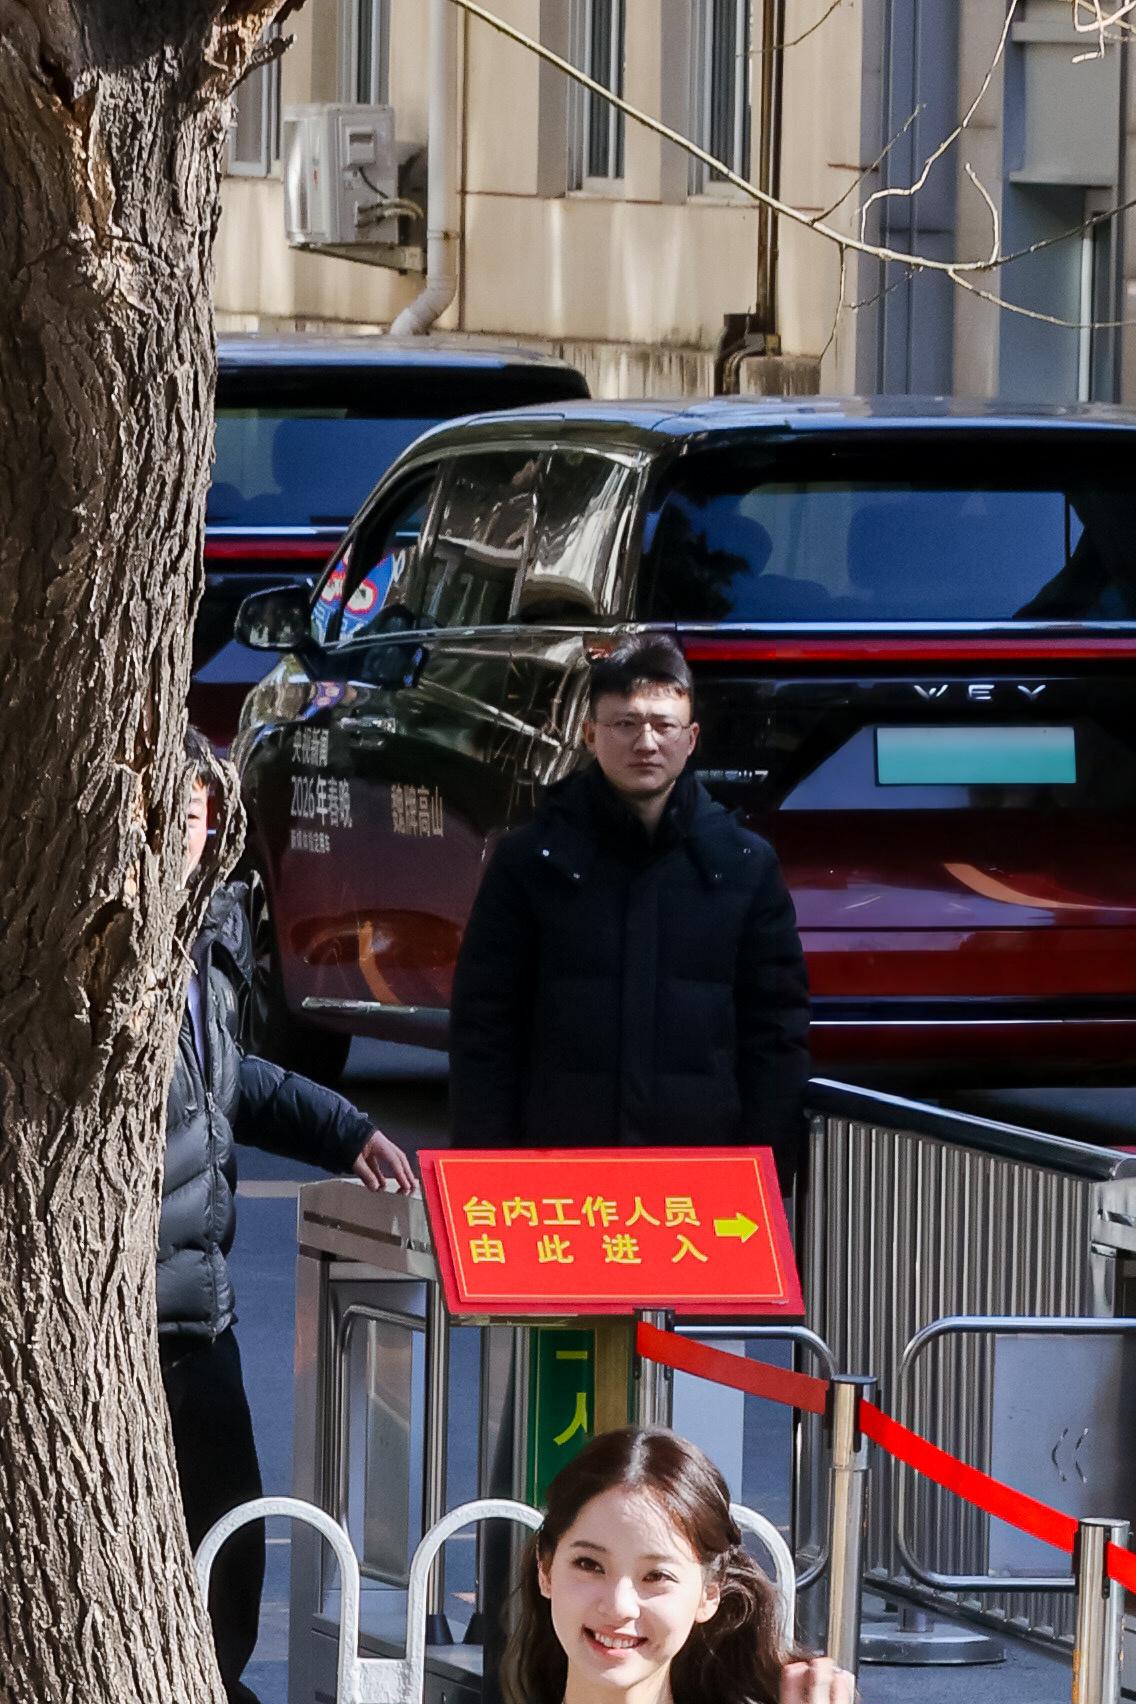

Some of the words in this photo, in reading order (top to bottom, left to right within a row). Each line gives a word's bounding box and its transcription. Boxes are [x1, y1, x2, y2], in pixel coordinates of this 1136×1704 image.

[913, 684, 1046, 700] WEY
[290, 773, 353, 828] 2026年春晚
[391, 784, 444, 837] 魏牌高山
[463, 1196, 701, 1228] 台内工作人员
[469, 1234, 708, 1264] 由此进入
